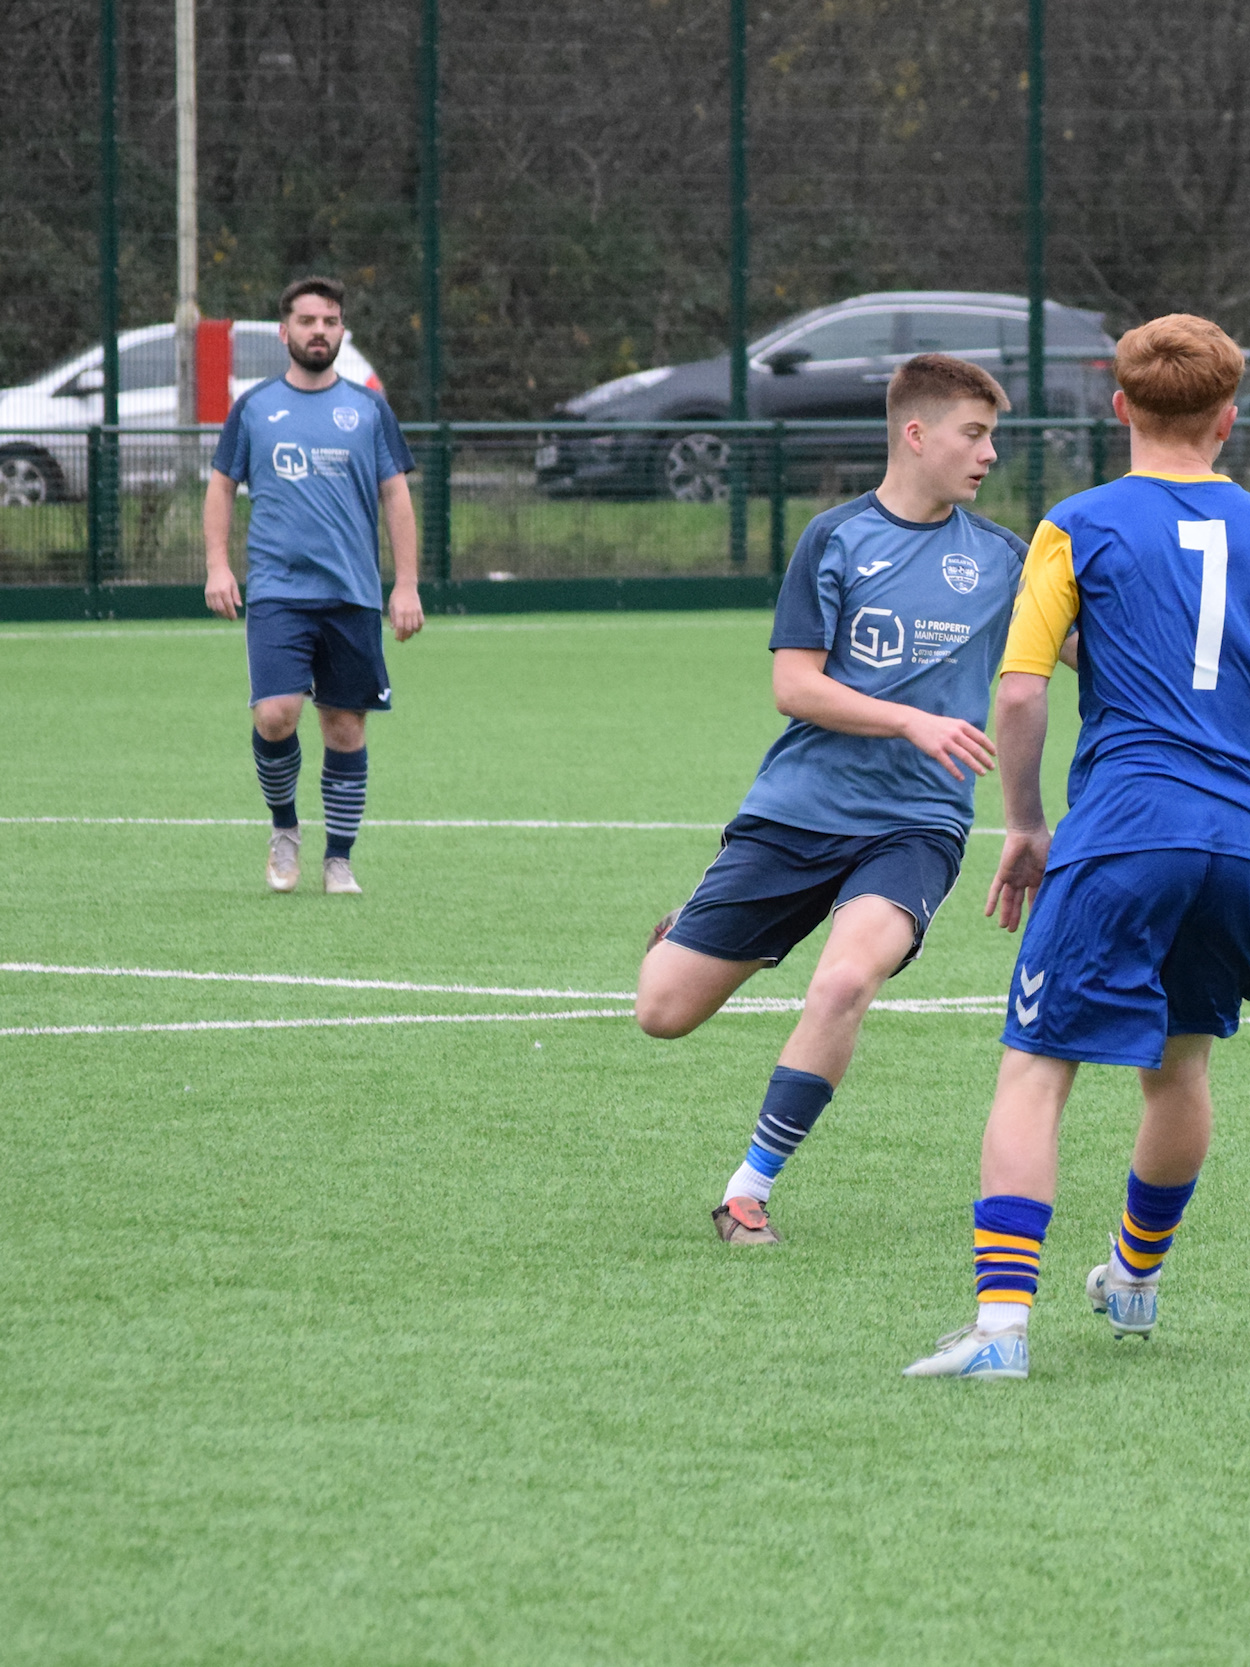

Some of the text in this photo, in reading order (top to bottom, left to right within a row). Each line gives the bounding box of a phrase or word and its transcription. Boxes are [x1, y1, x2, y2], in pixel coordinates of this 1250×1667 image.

[1177, 519, 1228, 690] 1
[914, 619, 970, 634] GJ PROPERTY
[914, 630, 970, 644] MAINTENANCE
